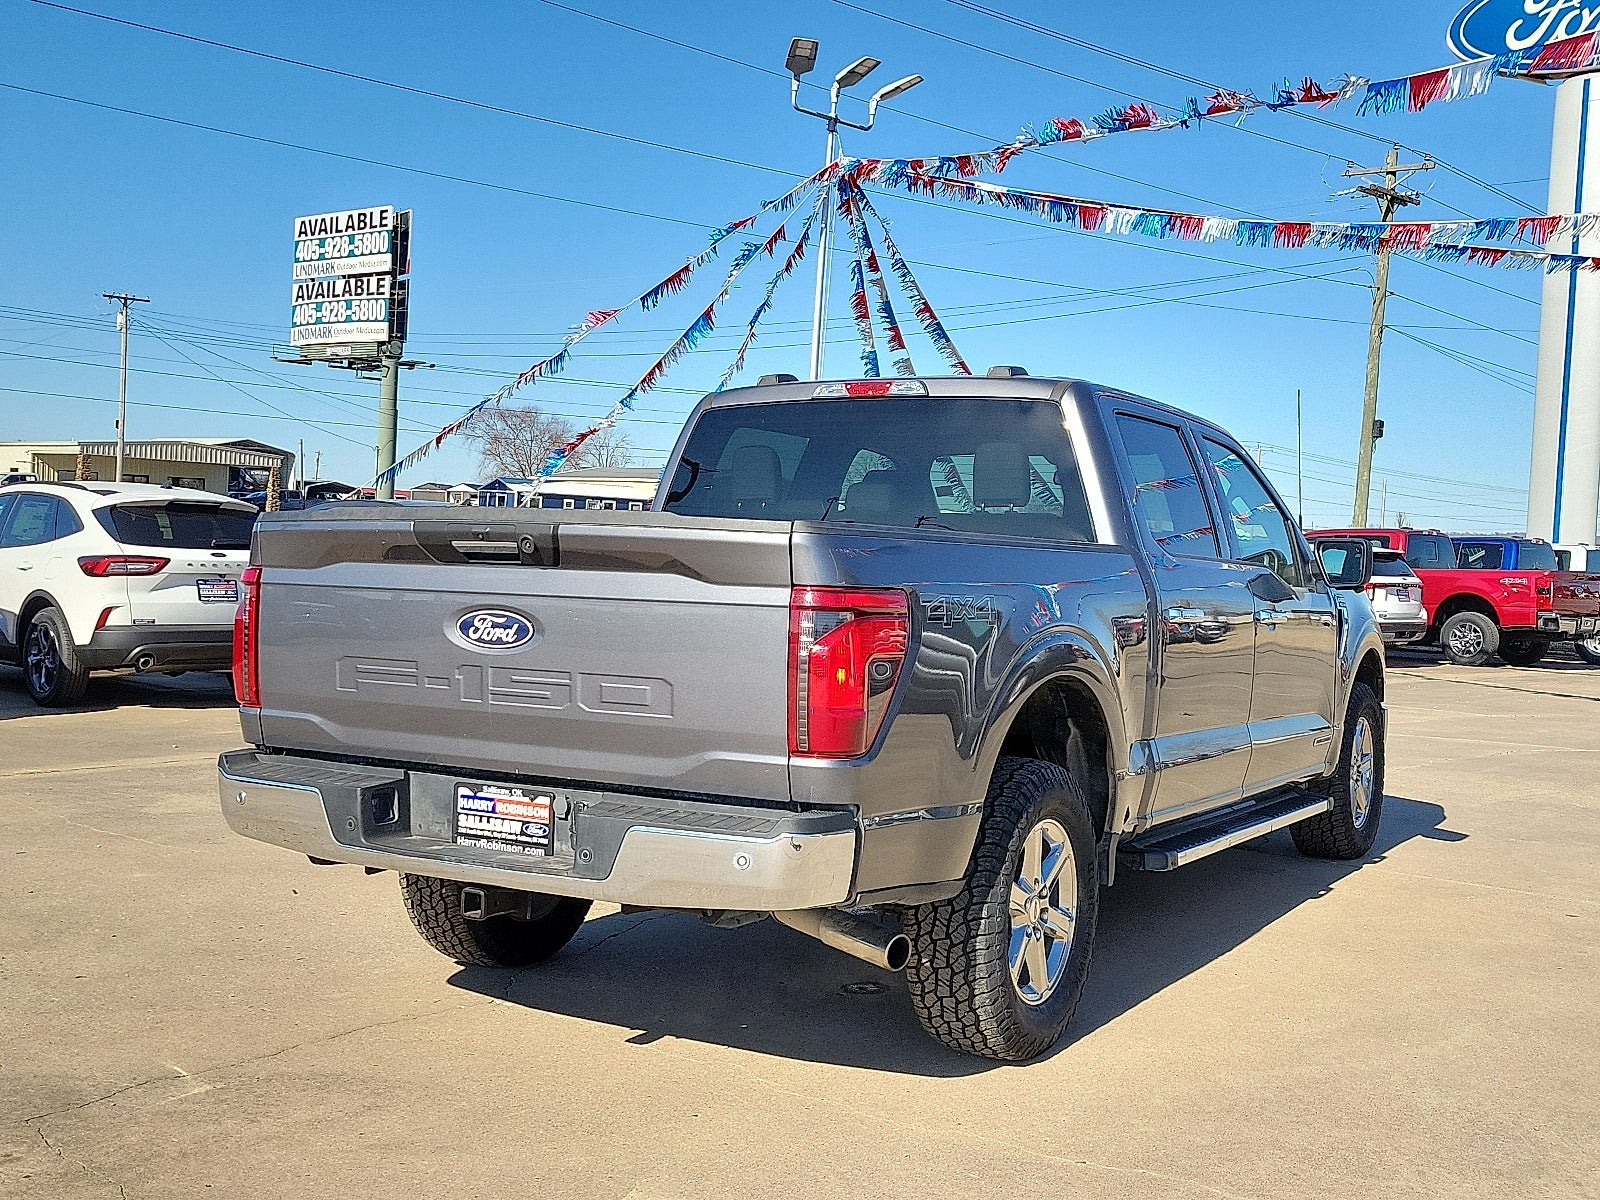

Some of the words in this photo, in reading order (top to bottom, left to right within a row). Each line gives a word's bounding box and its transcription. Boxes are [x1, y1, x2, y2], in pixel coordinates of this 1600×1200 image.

[1506, 0, 1600, 50] Fo
[297, 209, 389, 238] AVAILABLE
[295, 230, 389, 262] 405-928-5800
[295, 261, 336, 277] LINDMARK
[294, 277, 386, 302] AVAILABLE
[292, 299, 386, 326] 405-928-5800
[292, 326, 333, 342] LINDMARK
[468, 613, 519, 643] Ford
[335, 655, 674, 718] F-150
[511, 788, 524, 798] OK
[459, 797, 495, 812] HARRY
[496, 803, 548, 819] ROBINSON
[458, 814, 523, 835] SALLISAW
[457, 837, 545, 856] HarryRobinson.com
